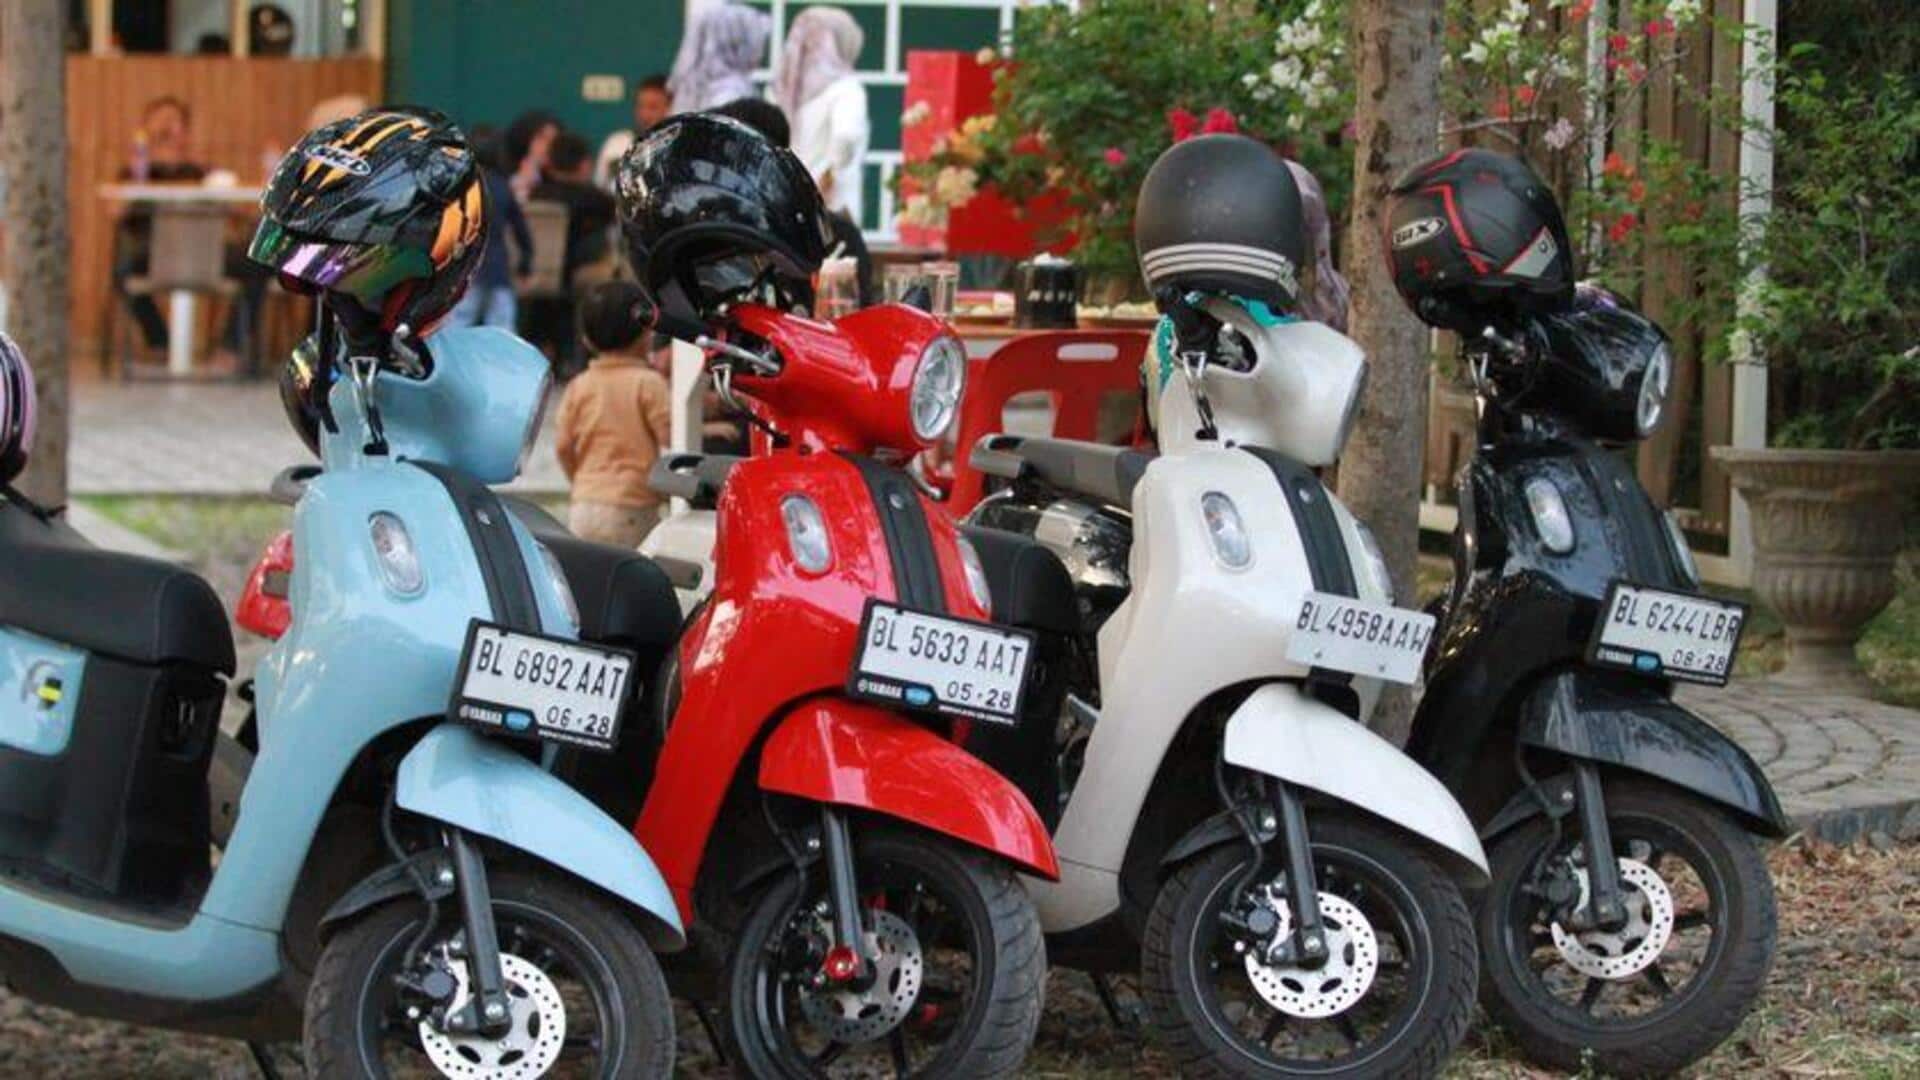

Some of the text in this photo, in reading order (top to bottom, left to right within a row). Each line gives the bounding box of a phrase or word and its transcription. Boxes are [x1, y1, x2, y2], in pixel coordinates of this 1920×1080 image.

[1297, 601, 1321, 633] BL
[1615, 594, 1741, 642] BL 6244 LBR
[477, 638, 623, 700] BL 6892 AAT
[872, 617, 1023, 676] BL 5633 AAT
